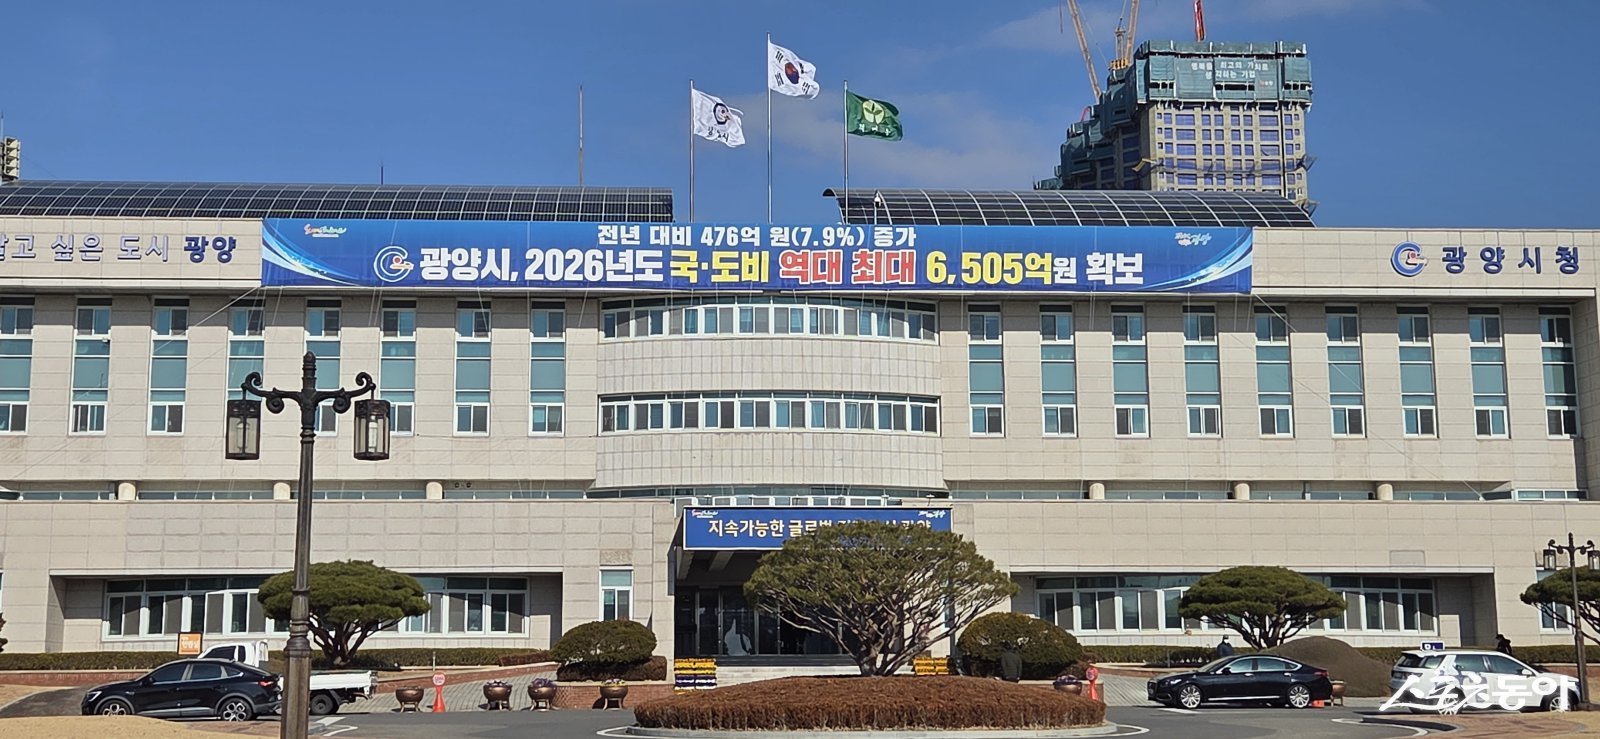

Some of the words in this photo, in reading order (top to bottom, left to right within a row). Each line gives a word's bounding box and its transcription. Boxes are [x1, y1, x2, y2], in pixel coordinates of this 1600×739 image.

[1241, 70, 1256, 79] 기업
[597, 225, 641, 246] 전년
[649, 225, 692, 247] 대비
[700, 226, 761, 247] 476억
[873, 226, 917, 247] 증가
[51, 233, 104, 262] 싶은
[117, 234, 170, 262] 도시
[184, 236, 237, 264] 광양
[419, 248, 518, 283] 광양시,
[525, 248, 664, 283] 2026년도
[669, 250, 770, 284] 국·도비
[779, 249, 843, 285] 역대
[851, 249, 917, 285] 최대
[1086, 252, 1144, 286] 확보
[708, 519, 784, 538] 지속가능한
